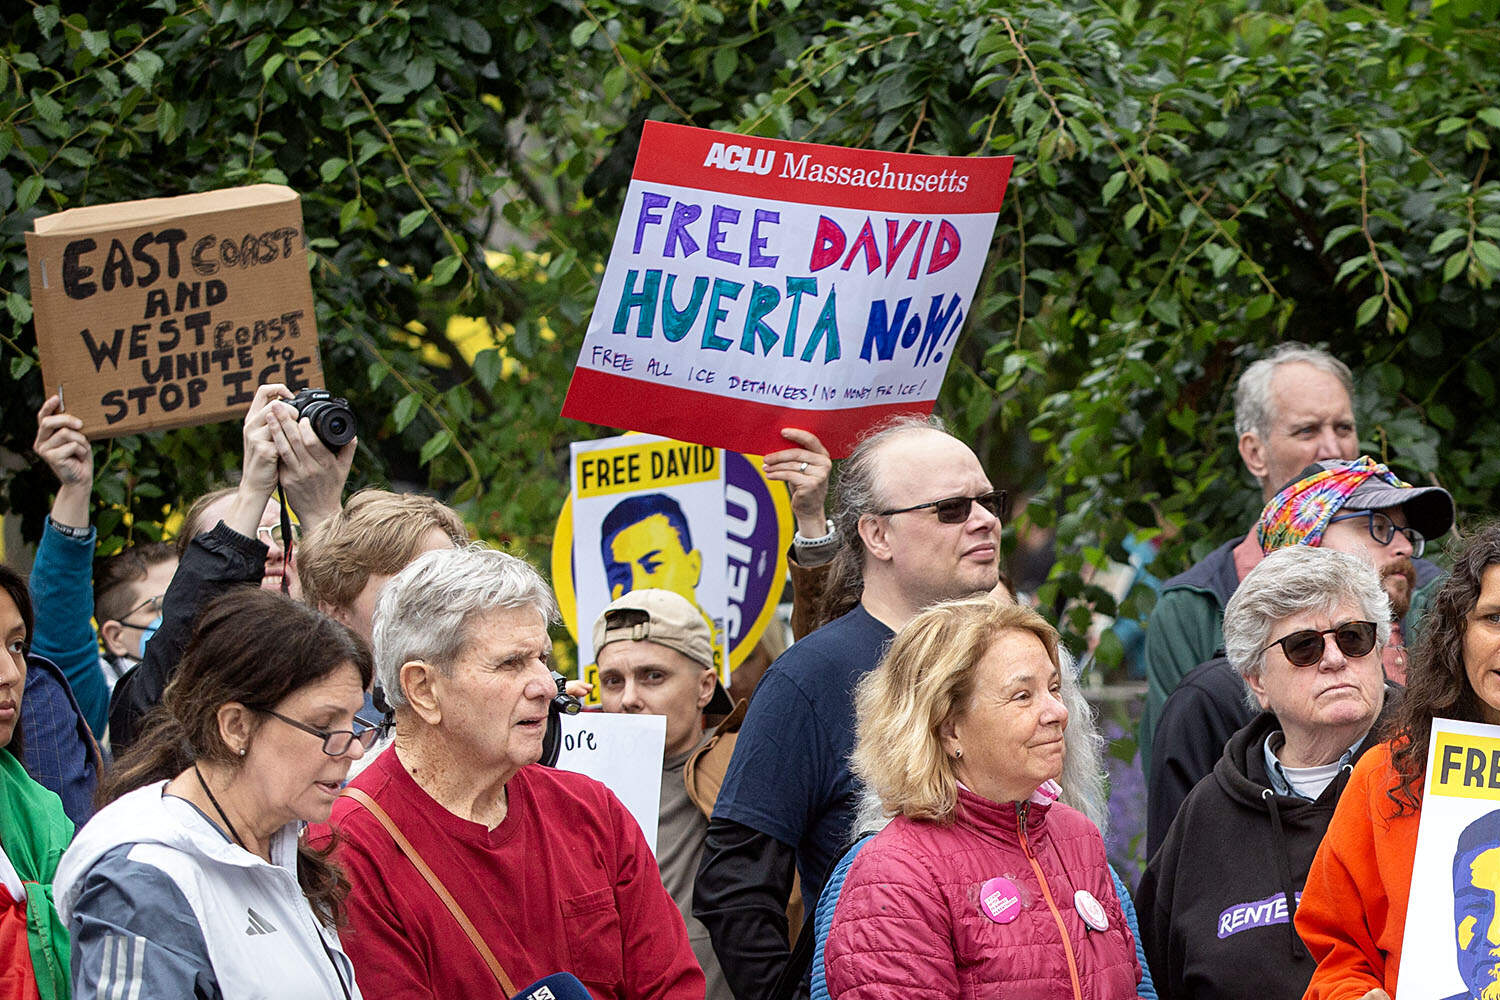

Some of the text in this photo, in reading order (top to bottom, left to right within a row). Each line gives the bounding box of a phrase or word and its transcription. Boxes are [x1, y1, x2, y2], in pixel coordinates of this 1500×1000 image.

[703, 142, 969, 195] ACLU Massachusetts
[633, 191, 963, 281] FREE DAVID
[62, 226, 299, 300] EAST COAST
[144, 278, 228, 319] AND
[612, 269, 841, 365] HUERTA
[81, 311, 212, 373] WEST
[142, 345, 295, 385] UNITE to
[592, 346, 634, 372] FREE
[646, 358, 673, 377] ALL
[687, 366, 716, 384] ICE
[820, 386, 836, 401] NO
[101, 378, 208, 425] STOP
[581, 445, 715, 490] FREE DAVID
[564, 729, 597, 751] ore
[1220, 897, 1296, 935] RENTE
